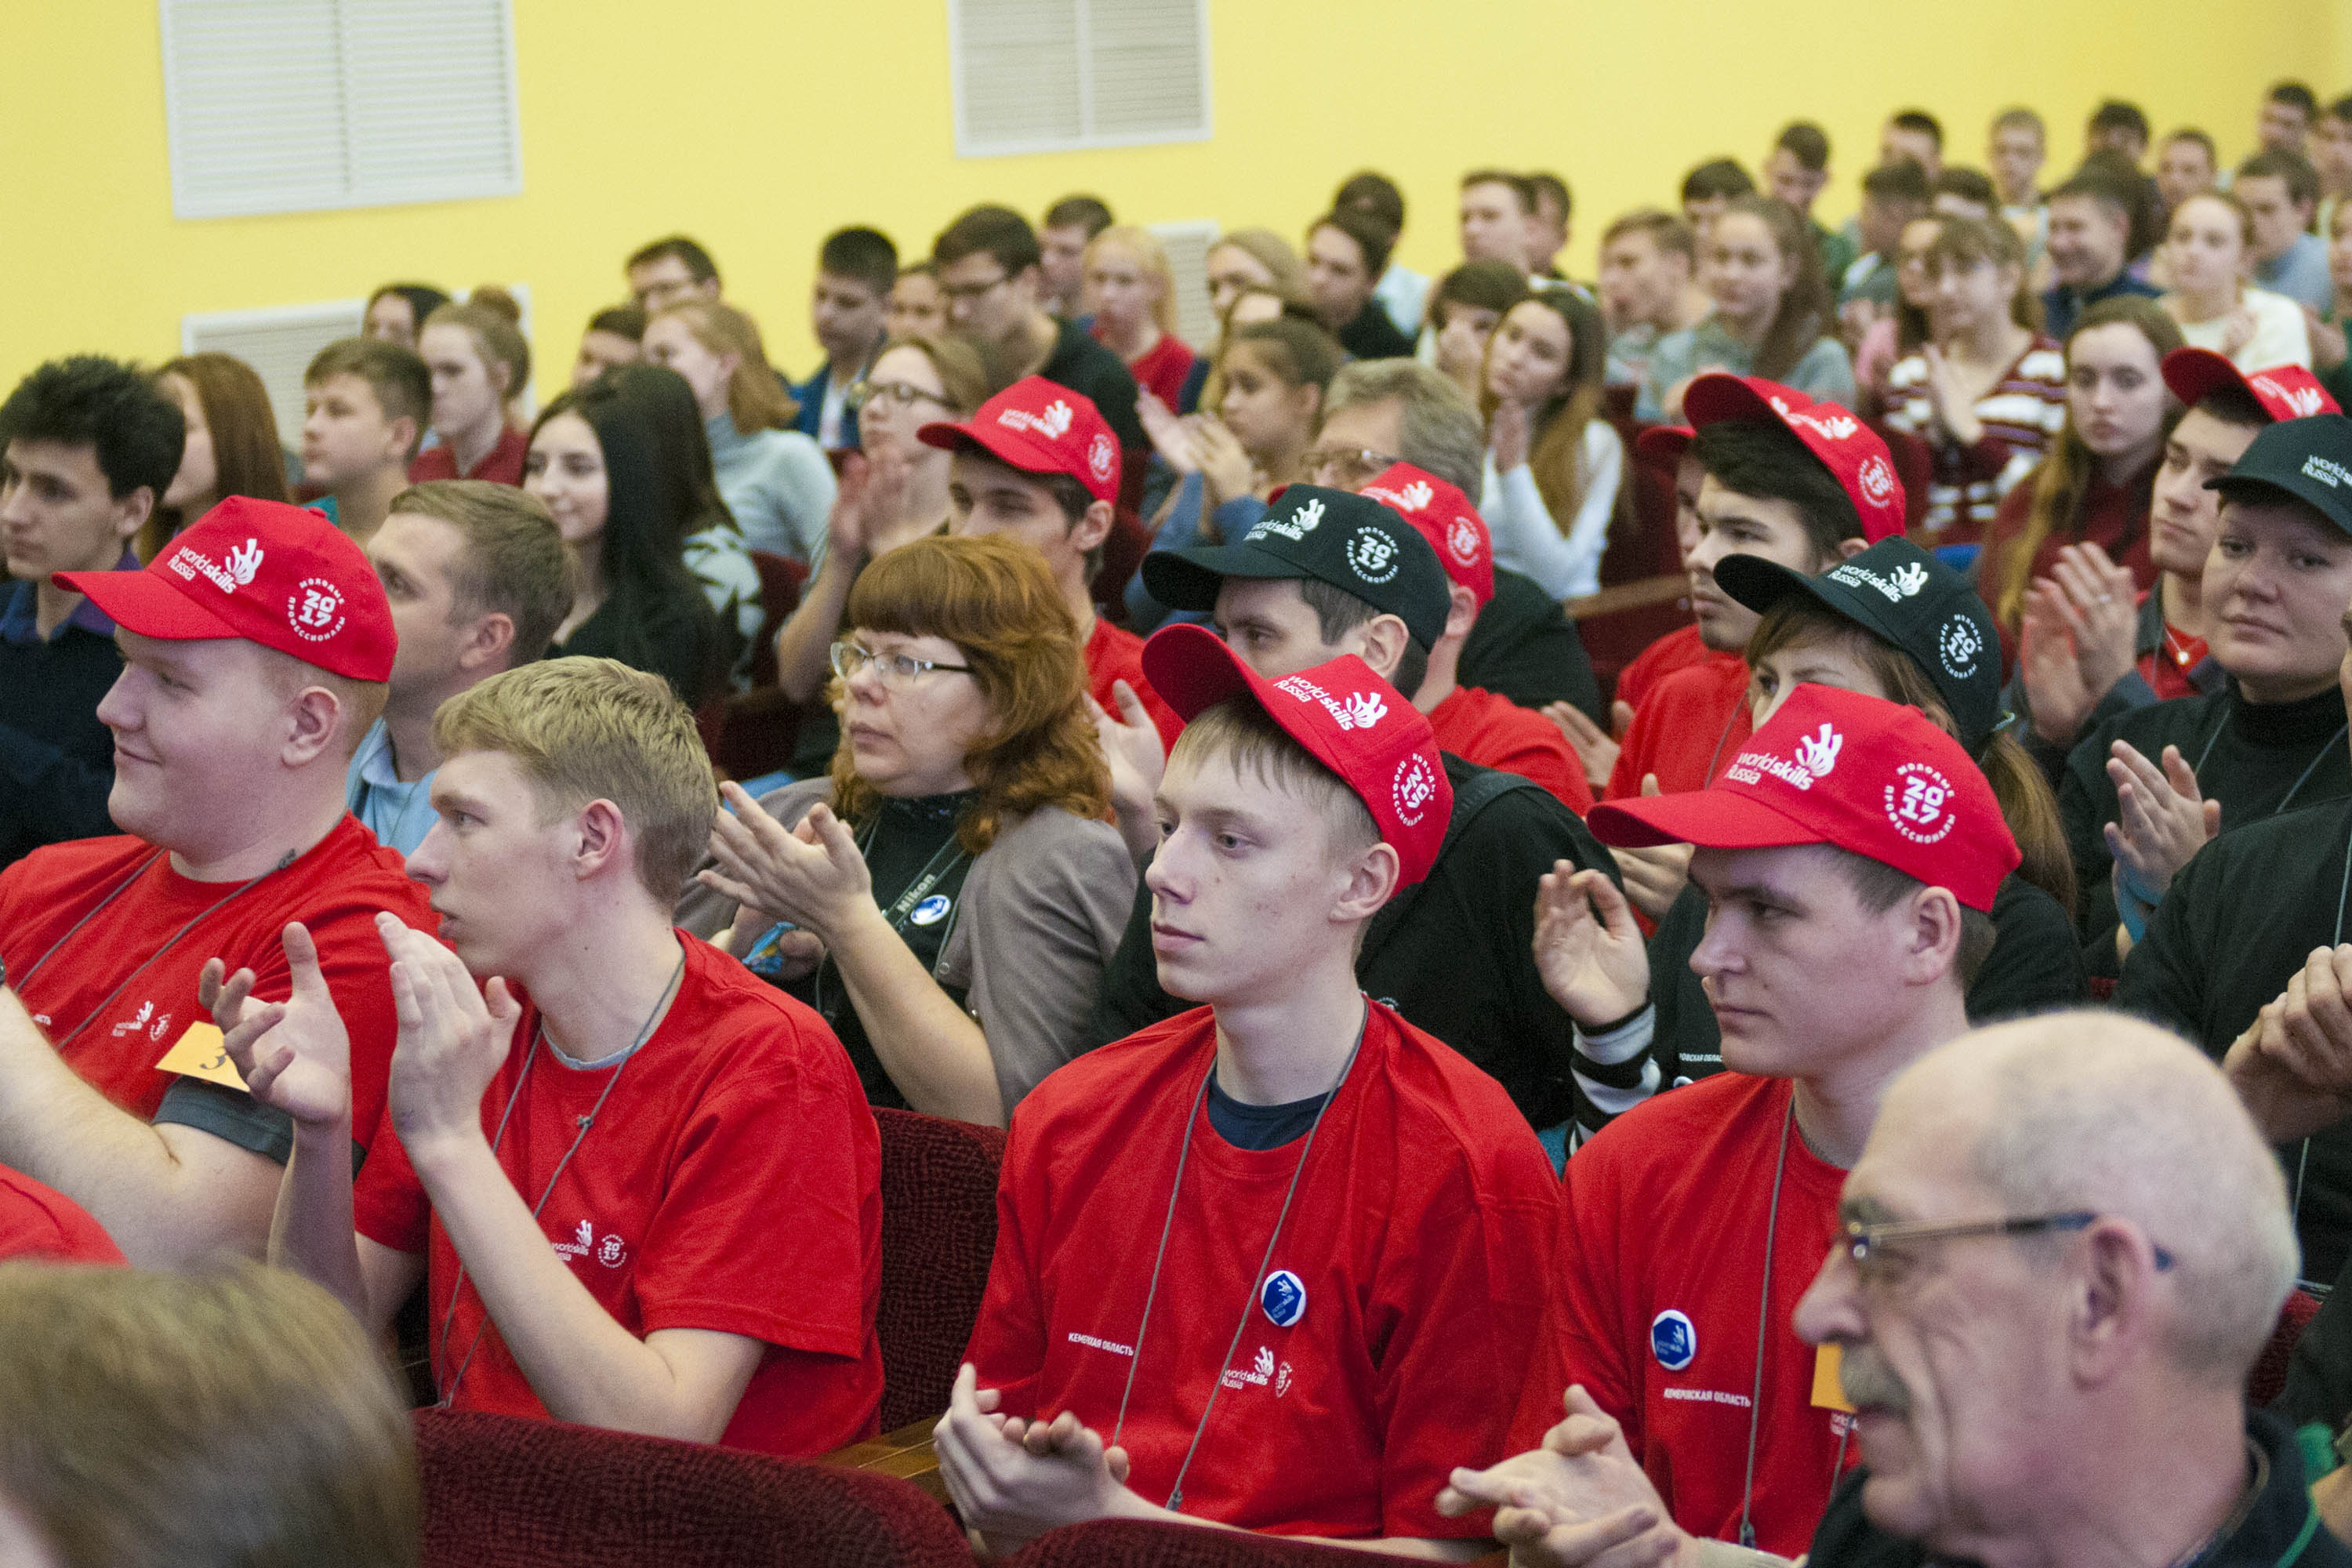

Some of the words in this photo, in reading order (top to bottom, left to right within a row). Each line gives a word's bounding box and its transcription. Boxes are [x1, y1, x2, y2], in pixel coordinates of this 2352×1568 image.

[2301, 462, 2339, 488] Russia
[1356, 548, 1388, 570] 17
[1360, 535, 1392, 557] 20
[167, 554, 196, 582] Russia
[178, 546, 237, 594] worldskills
[1828, 570, 1861, 588] Russia
[1839, 564, 1902, 603] worldskills
[305, 589, 336, 614] 20
[298, 605, 332, 627] 17
[1946, 637, 1969, 662] 17
[1953, 624, 1976, 655] 20
[1273, 680, 1311, 702] Russia
[1288, 675, 1354, 731] worldskills
[1409, 764, 1430, 800] 20
[1725, 764, 1762, 785] Russia
[1737, 752, 1814, 790] worldskills
[1896, 763, 1955, 798] МОЛОДЫЕ
[1400, 777, 1420, 809] 17
[1904, 775, 1944, 808] 20
[1884, 785, 1956, 844] ПРОФЕССИОНАЛЫ
[1899, 795, 1940, 824] 17
[897, 873, 935, 912] Nikon
[603, 1250, 619, 1261] 17
[604, 1241, 620, 1251] 20
